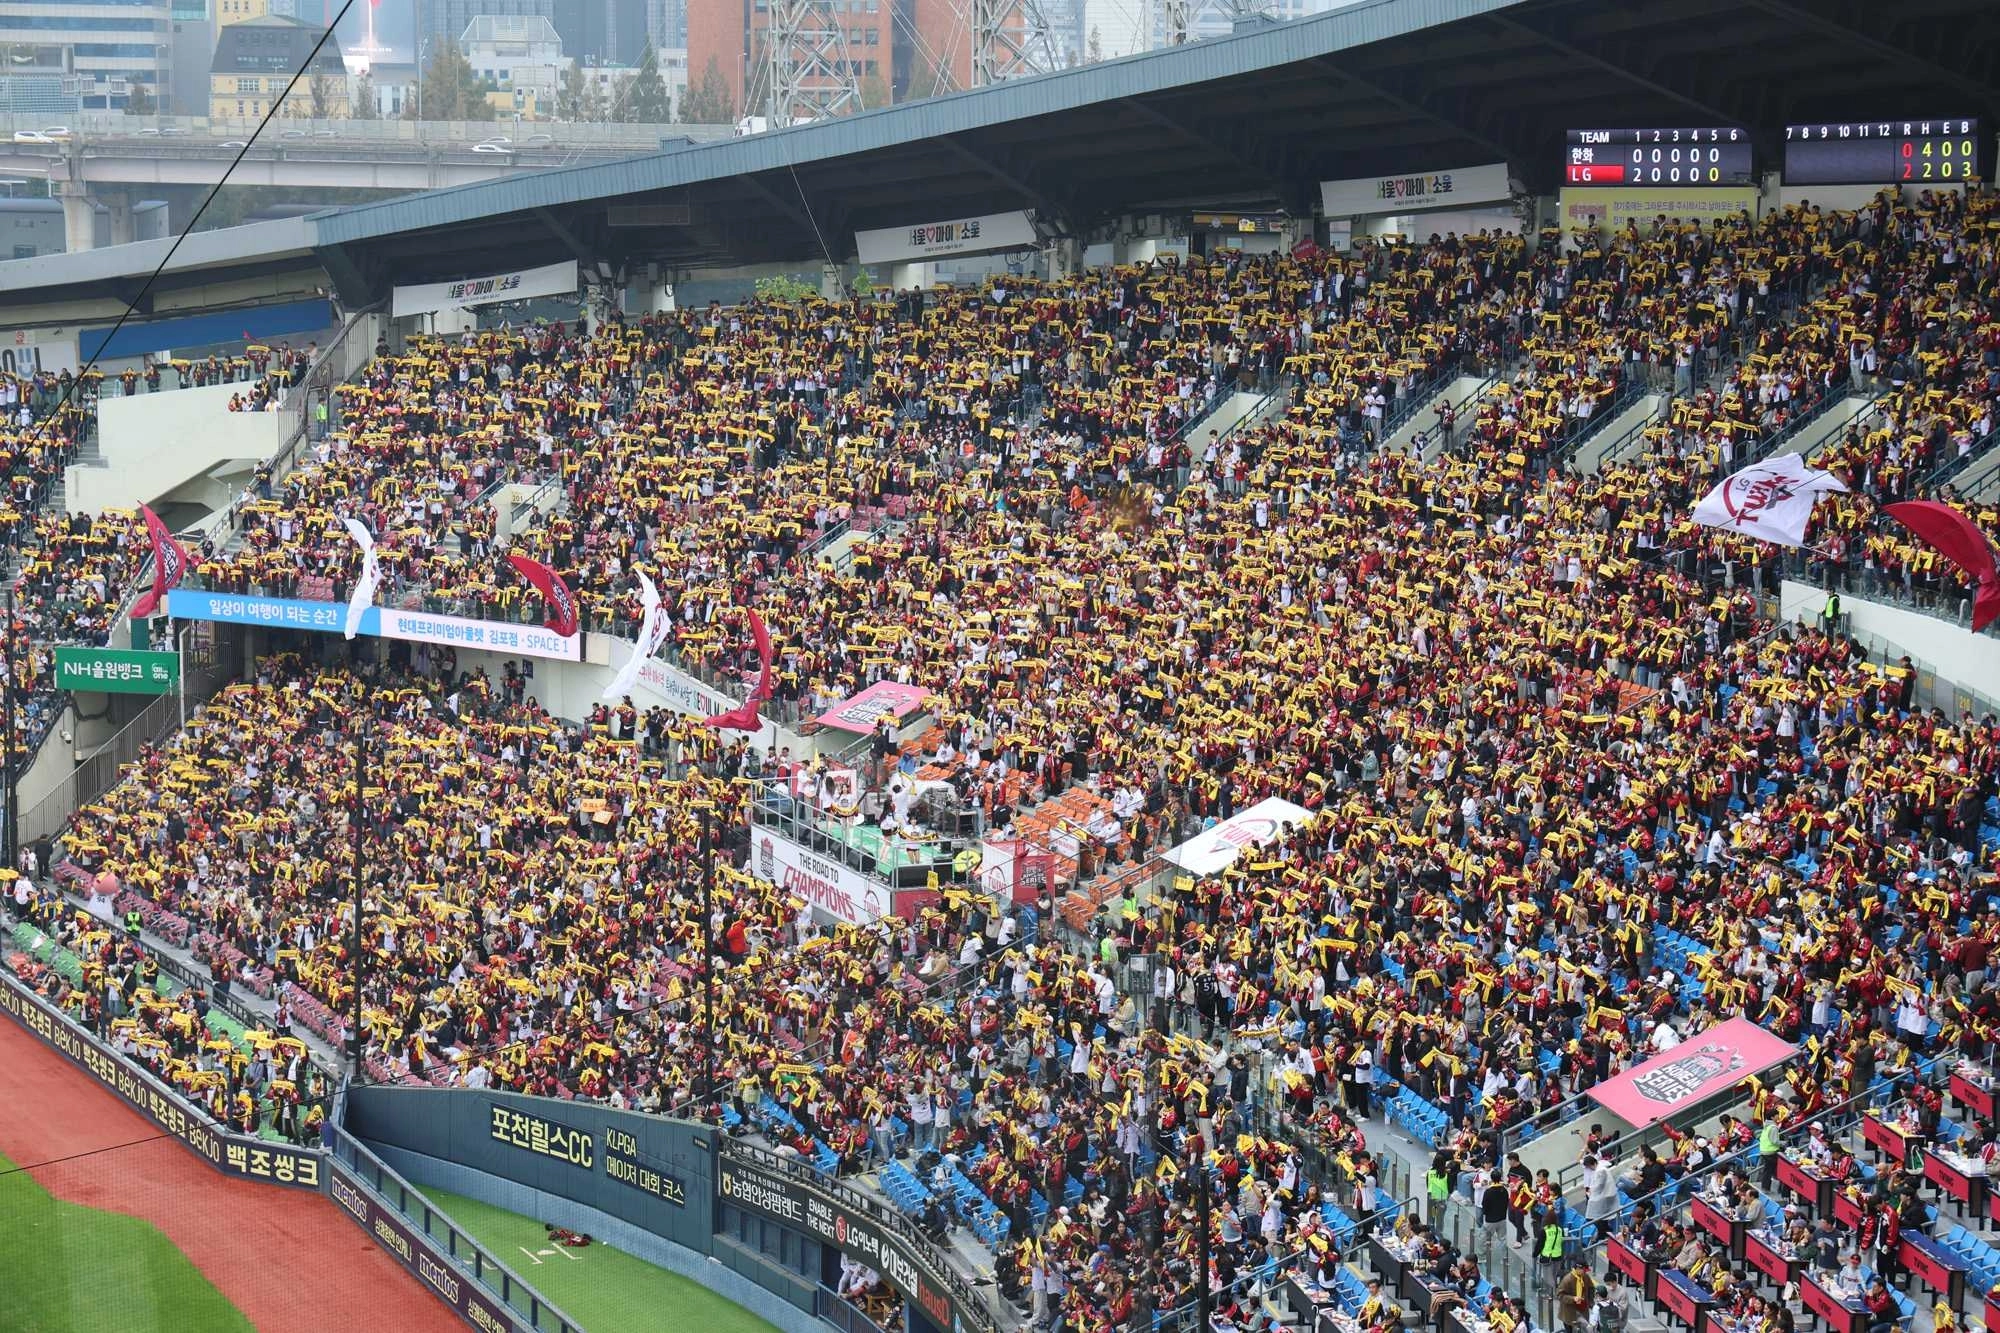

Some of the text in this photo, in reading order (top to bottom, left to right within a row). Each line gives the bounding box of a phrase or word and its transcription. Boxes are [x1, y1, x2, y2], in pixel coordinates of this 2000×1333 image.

[1579, 129, 1738, 144] TEAM 1 2 3 4 5 6
[1785, 121, 1969, 140] 7 8 9 10 11 12 R H E B
[1571, 147, 1719, 165] 한화 0 0 0 0 0
[1902, 140, 1972, 158] 0 4 0 0
[1571, 167, 1719, 182] LG 2 0 0 0 0
[1903, 161, 1972, 178] 2 2 0 3
[1735, 477, 1751, 492] LG
[209, 600, 337, 625] 일상이 여행이 되는 순간
[398, 617, 484, 643] 현대프리미엄아울렛
[489, 629, 518, 647] 김포점
[527, 634, 560, 652] SPACE
[64, 660, 143, 680] NH올원뱅크
[799, 852, 839, 884] THE ROAD TO
[783, 865, 856, 922] CHAMPIONS
[22, 999, 52, 1040] 백조씽크
[83, 1043, 116, 1086] 백조씽크
[1661, 1064, 1704, 1091] KOREAN
[1632, 1069, 1692, 1104] SERIES
[150, 1090, 186, 1138] 백조씽크
[491, 1107, 593, 1169] 포천힐스CC
[606, 1129, 637, 1157] KLPGA
[226, 1144, 319, 1186] 백조씽크
[606, 1154, 684, 1205] 메이저 대회 코스
[331, 1175, 368, 1222] mentos
[732, 1176, 803, 1223] 농협안성팜랜드
[808, 1198, 833, 1222] ENABLE
[806, 1212, 835, 1240] THE NEXT
[419, 1252, 459, 1304] mentos
